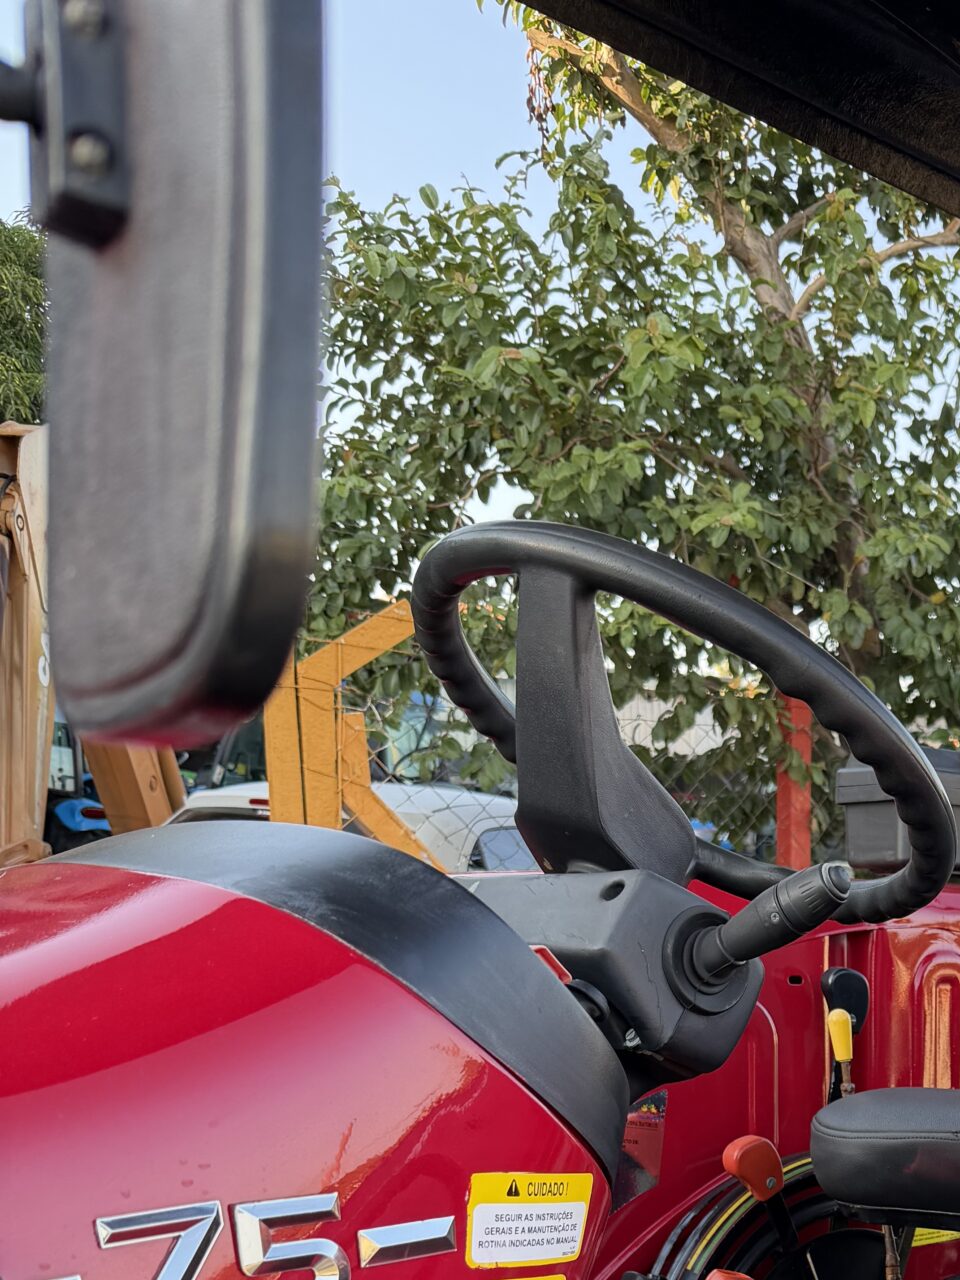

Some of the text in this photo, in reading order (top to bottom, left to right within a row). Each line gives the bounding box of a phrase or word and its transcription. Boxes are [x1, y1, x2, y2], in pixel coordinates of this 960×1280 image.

[527, 1182, 564, 1197] CUIDADO
[494, 1211, 573, 1222] SEGUIR AS INSTRUÇÕES
[484, 1226, 513, 1236] GERAIS
[527, 1223, 570, 1234] MANUTENÇÃO
[570, 1223, 578, 1231] DE
[478, 1236, 577, 1249] ROTINA INDICADAS NO MANUAL
